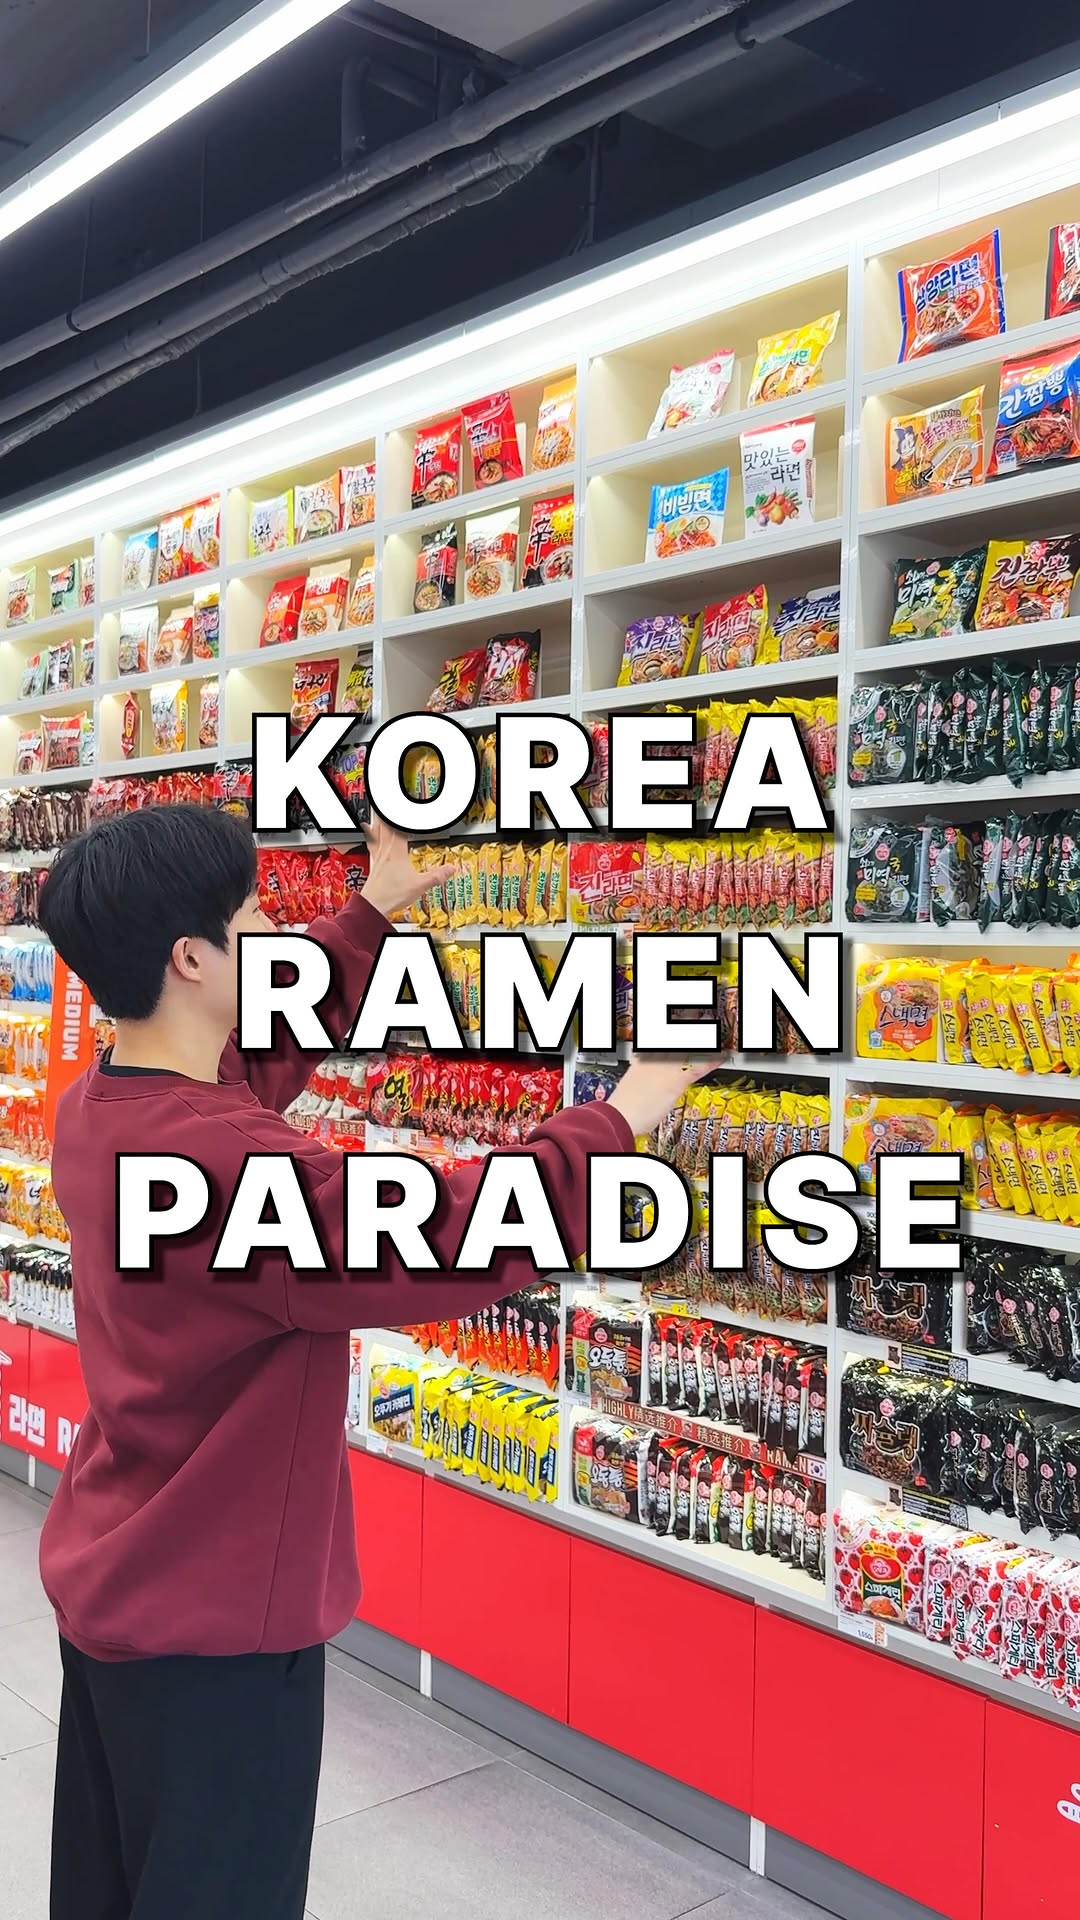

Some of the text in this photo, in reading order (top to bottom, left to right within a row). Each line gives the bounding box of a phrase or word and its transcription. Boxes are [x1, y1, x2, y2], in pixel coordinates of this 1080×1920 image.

[917, 253, 979, 312] 삼양라면
[1000, 369, 1067, 420] 간짬뽕
[744, 447, 790, 471] 맛있는
[771, 461, 800, 484] 라면
[662, 489, 712, 517] 비빔면
[530, 518, 553, 565] 辛
[992, 555, 1070, 587] 진짬뽕
[703, 611, 751, 648] 진라면
[579, 870, 634, 905] 진라면
[62, 971, 83, 1061] MEDIUM
[879, 1005, 928, 1029] 스낵면
[9, 1393, 46, 1448] 라면
[602, 1400, 679, 1433] HIGHLY 精选推介
[697, 1426, 746, 1452] 精选推介
[851, 1408, 921, 1464] 짜슐랭
